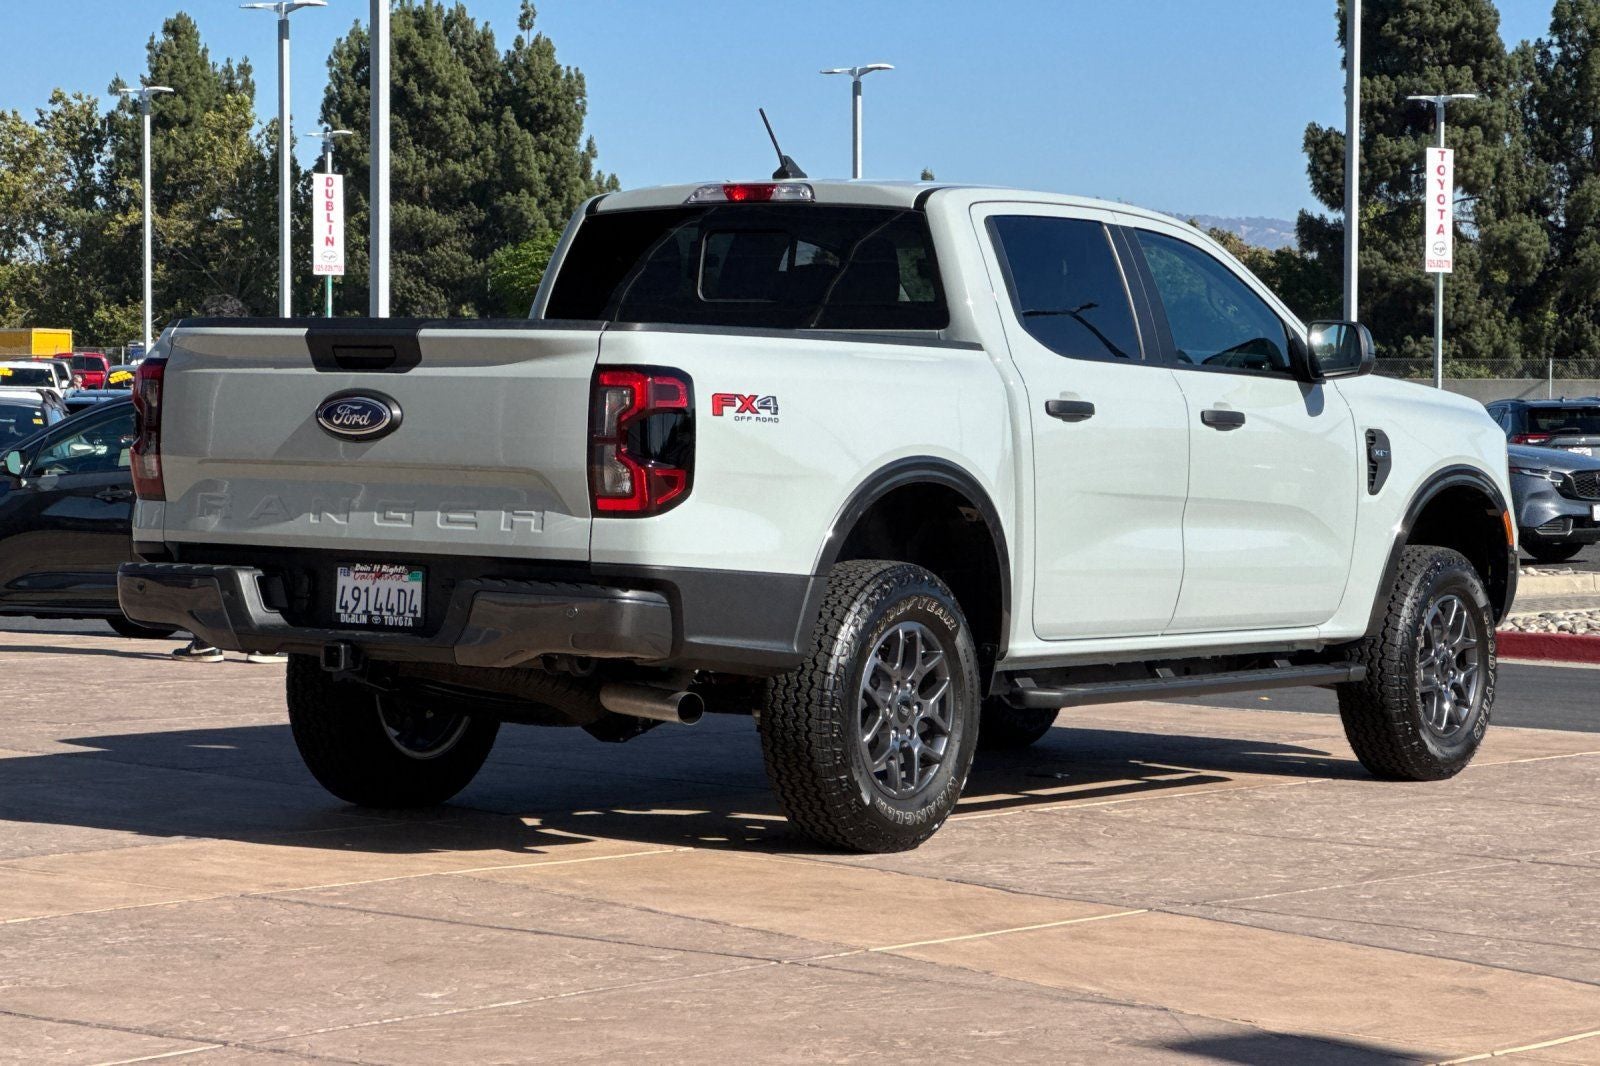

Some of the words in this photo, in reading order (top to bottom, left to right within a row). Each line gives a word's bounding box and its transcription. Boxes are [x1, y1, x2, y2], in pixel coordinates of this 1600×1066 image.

[1436, 150, 1446, 236] TOYOTA
[325, 176, 335, 247] DUBLIN
[332, 404, 372, 425] Ford
[712, 393, 778, 416] FX4
[196, 492, 546, 534] RANGER
[338, 585, 418, 617] 49144D4
[340, 613, 368, 624] DUBLIN
[384, 615, 413, 627] TOYOTA
